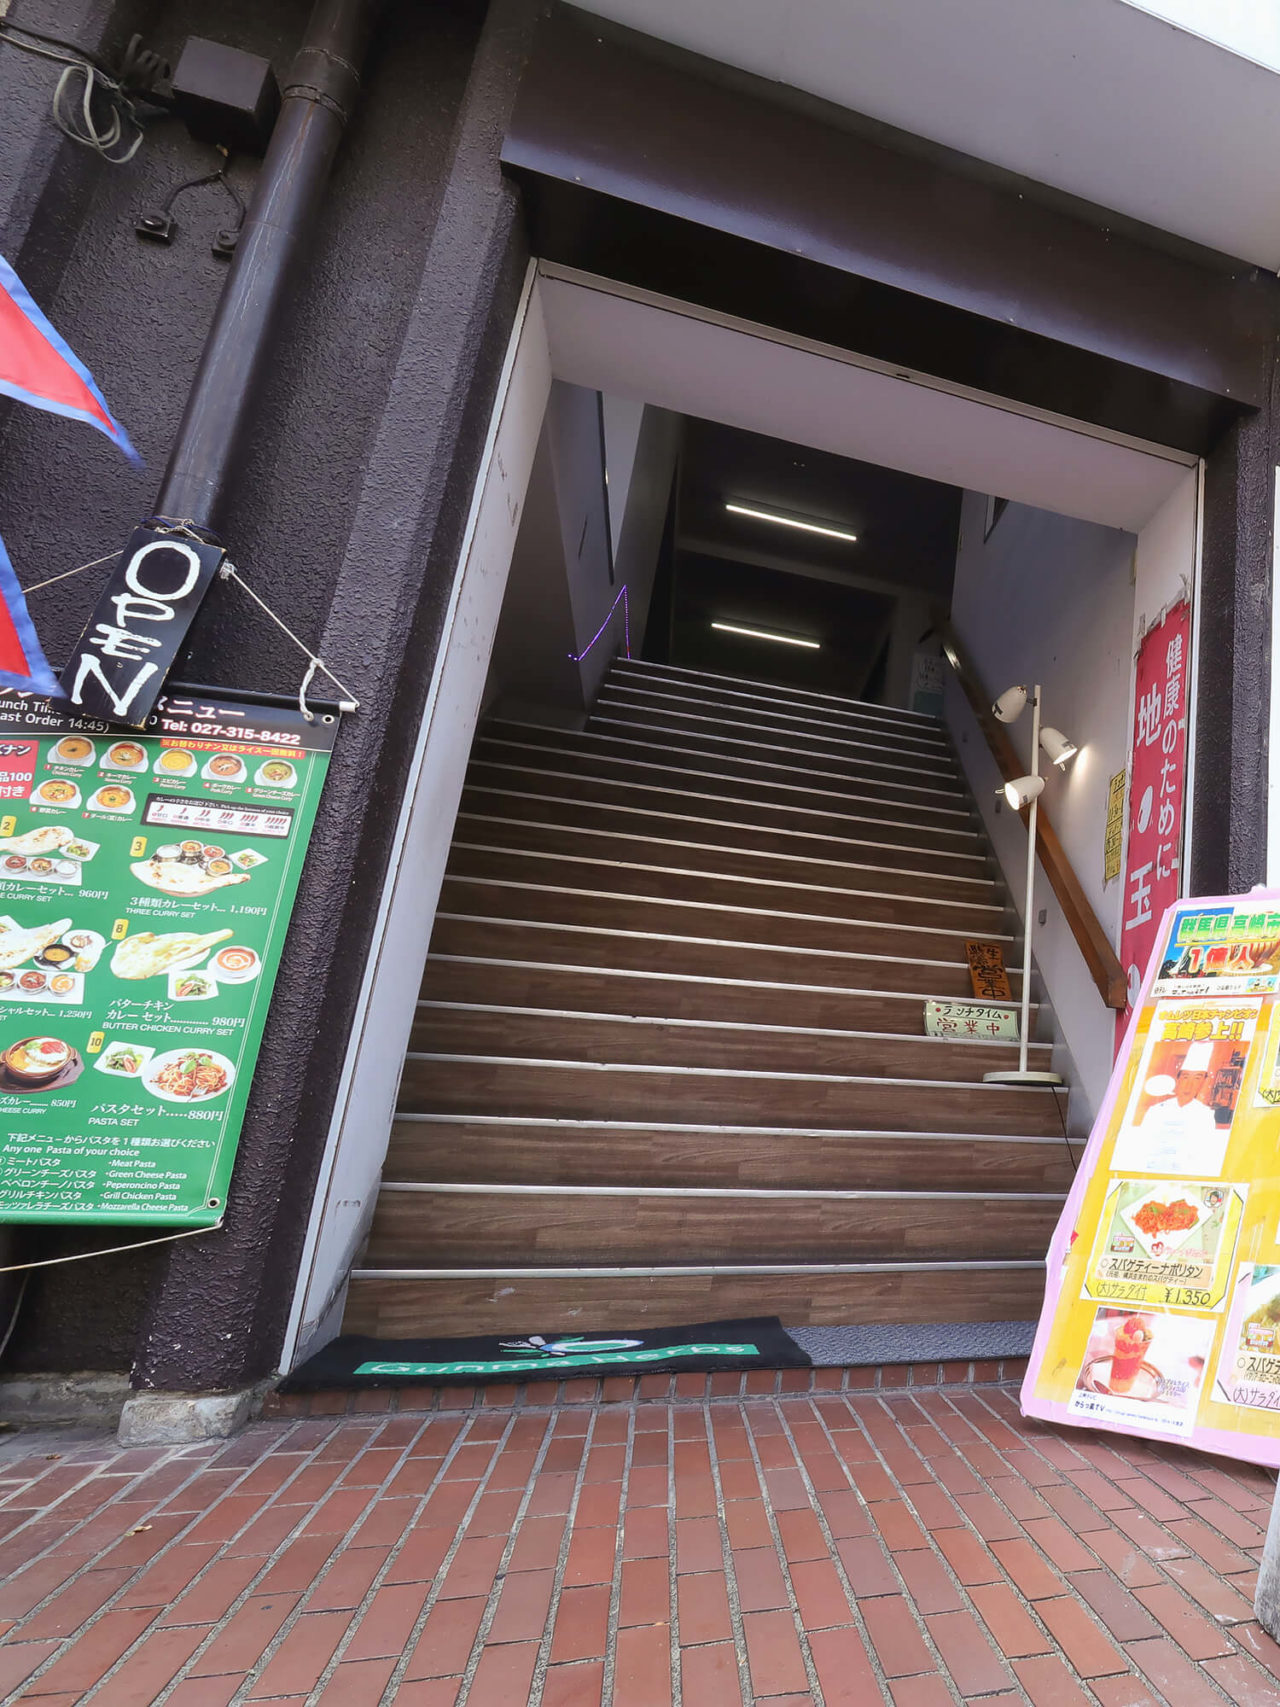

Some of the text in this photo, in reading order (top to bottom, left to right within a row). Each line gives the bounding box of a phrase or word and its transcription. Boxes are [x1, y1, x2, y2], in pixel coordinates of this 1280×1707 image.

[71, 540, 200, 716] OPEN
[157, 696, 245, 719] ニュー
[25, 714, 63, 727] Order
[68, 718, 110, 734] 14:45)
[162, 719, 301, 745] Tel: 027-315-8422
[1156, 633, 1183, 880] 健康のために
[3, 821, 11, 831] 2
[135, 841, 142, 851] 3
[79, 890, 109, 900] 960円
[126, 907, 152, 916] THREE
[153, 909, 181, 917] CURRY
[116, 922, 123, 933] 8
[1188, 944, 1255, 973] 1億人
[109, 998, 174, 1011] バターチキン
[943, 1005, 1002, 1020] ランチタイム
[1159, 1008, 1258, 1020] オムレツ日本チャンピオン
[106, 1009, 138, 1020] カレー
[212, 1017, 245, 1028] 980円
[102, 1022, 234, 1036] BUTTER CHICKEN CURRY SET
[936, 1017, 1000, 1036] 営業中
[1161, 1020, 1245, 1041] 高崎参上!!
[91, 1037, 102, 1047] 10
[51, 1099, 77, 1108] 850円
[188, 1110, 223, 1121] 880円
[88, 1117, 140, 1127] PASTA SET
[2, 1144, 140, 1157] Any one Pasta of your choice
[134, 1160, 156, 1168] Pasta
[4, 1167, 96, 1178] グリーンチーズパスタ
[135, 1171, 164, 1179] Cheese
[165, 1172, 187, 1180] Pasta
[159, 1182, 181, 1190] Pasta
[121, 1192, 153, 1201] Chicken
[155, 1193, 177, 1201] Pasta
[141, 1203, 168, 1211] Cheese
[168, 1204, 189, 1212] Pasta
[1109, 1258, 1203, 1278] スパゲティーナポリタン
